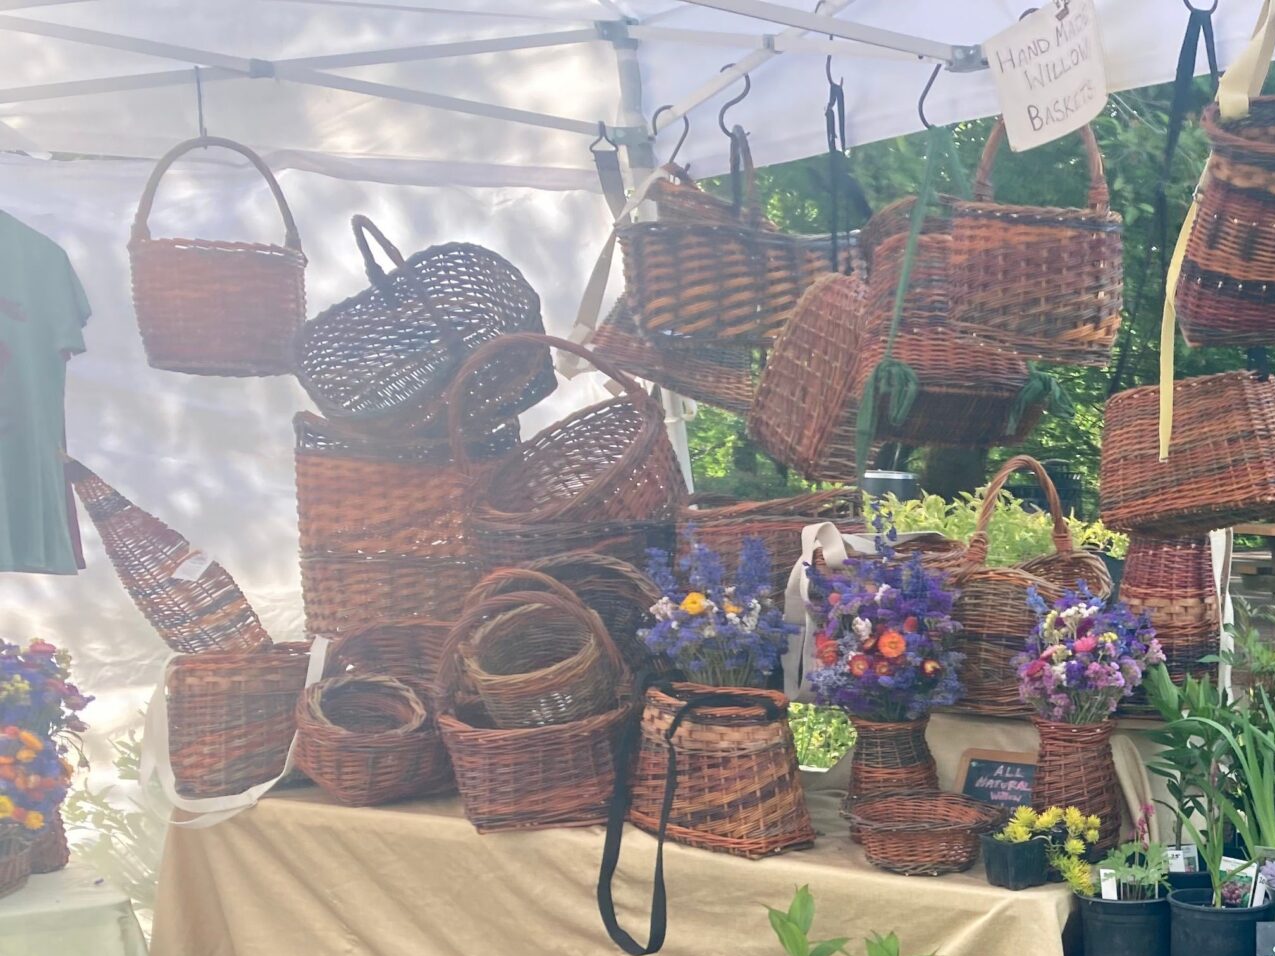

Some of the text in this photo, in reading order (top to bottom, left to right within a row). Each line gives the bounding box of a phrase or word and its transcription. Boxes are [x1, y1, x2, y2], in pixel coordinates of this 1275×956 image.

[996, 38, 1051, 73] HAND
[1024, 37, 1090, 91] WILLOW
[1027, 79, 1096, 132] BASKETS
[975, 776, 1032, 792] NATURAL
[993, 764, 1024, 778] ALL
